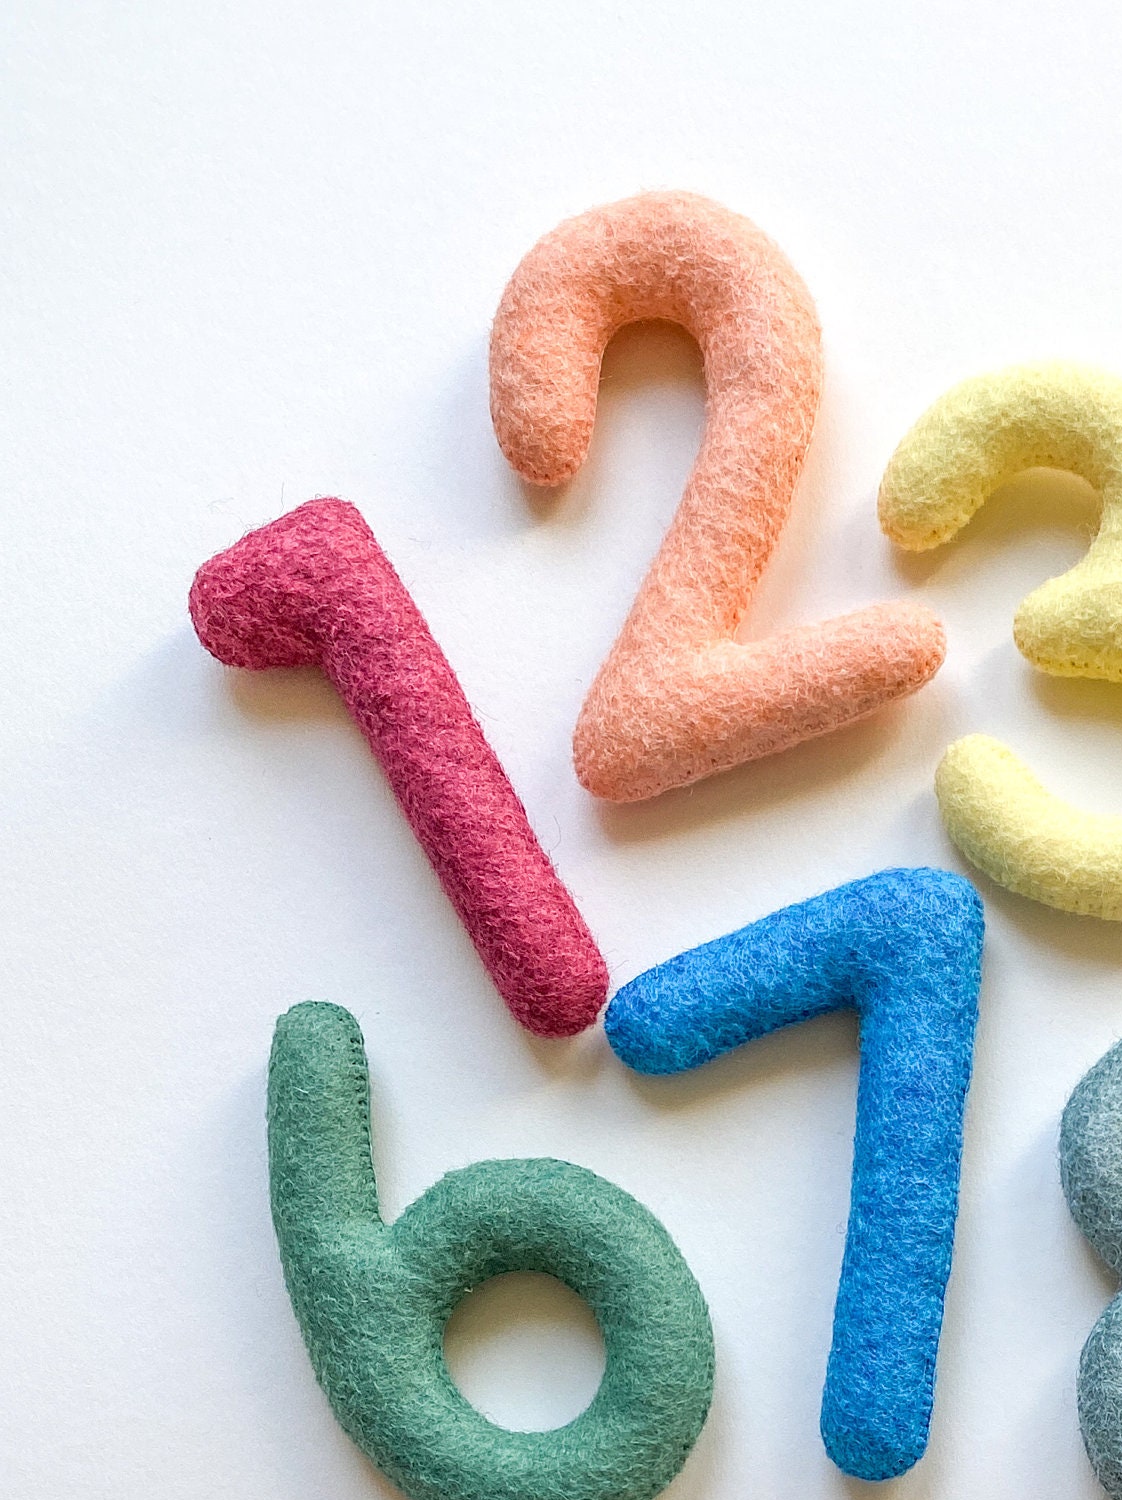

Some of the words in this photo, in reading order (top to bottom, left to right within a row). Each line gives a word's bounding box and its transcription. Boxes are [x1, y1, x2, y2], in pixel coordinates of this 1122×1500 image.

[189, 497, 610, 1038] 1
[489, 190, 946, 804] 2
[605, 866, 985, 1480] 7
